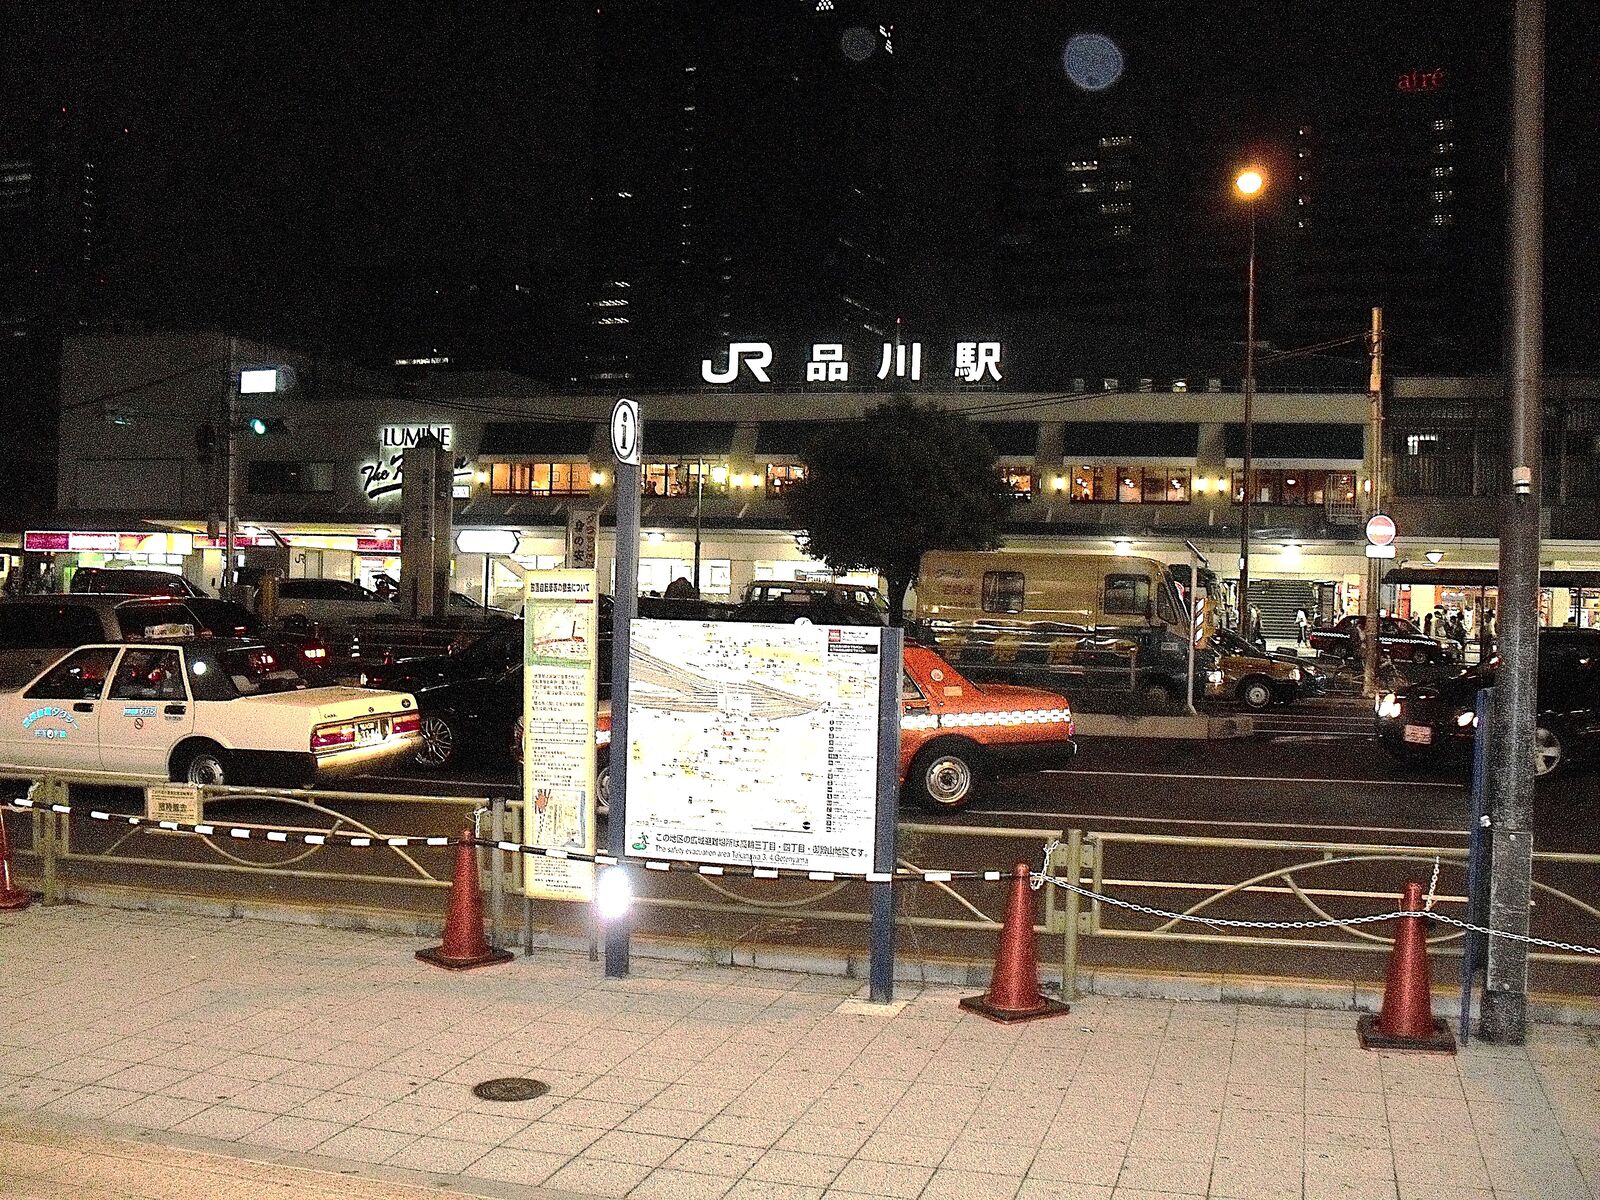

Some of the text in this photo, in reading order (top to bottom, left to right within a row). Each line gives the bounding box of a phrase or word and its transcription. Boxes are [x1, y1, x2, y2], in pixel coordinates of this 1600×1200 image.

[701, 342, 1003, 384] JR 品川駅
[655, 844, 666, 853] The
[667, 846, 684, 855] safety
